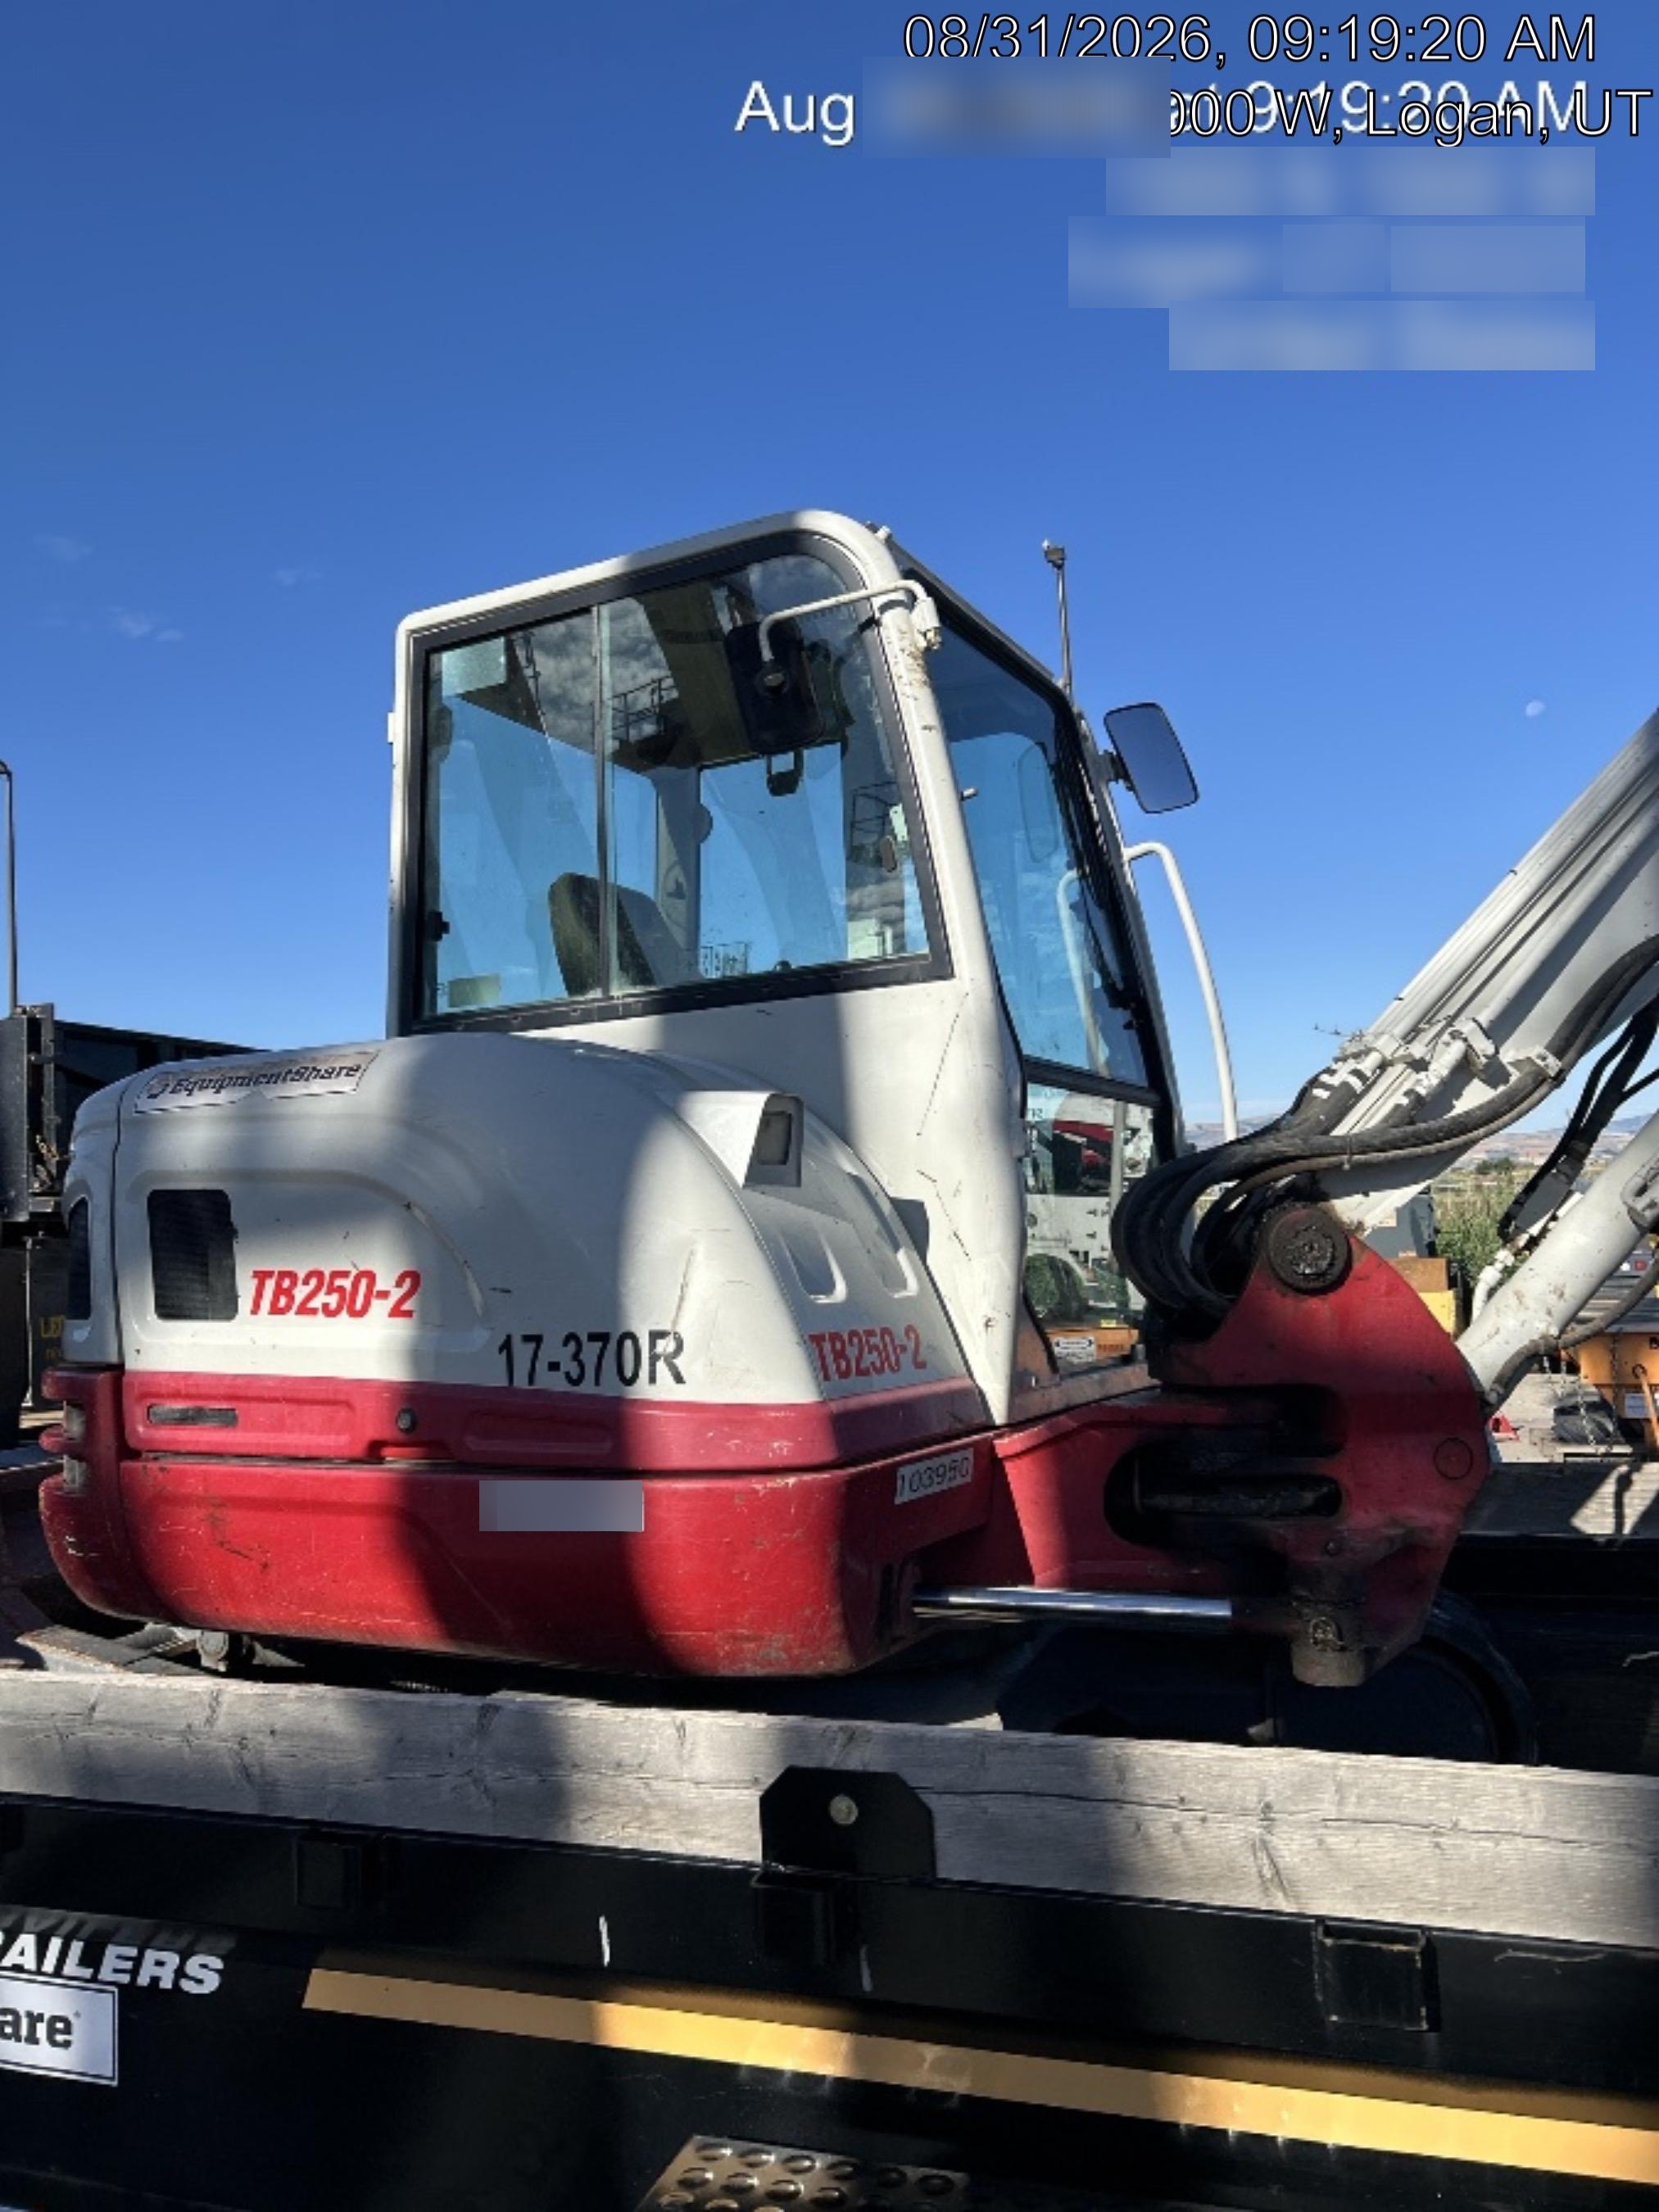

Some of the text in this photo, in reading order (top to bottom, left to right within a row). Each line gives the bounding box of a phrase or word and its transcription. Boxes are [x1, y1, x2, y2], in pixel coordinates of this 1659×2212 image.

[169, 1063, 362, 1097] EquipmentShare
[250, 1269, 421, 1319] TB250-2
[498, 1329, 687, 1387] 17-370R
[809, 1324, 927, 1382] TB250-2
[0, 1930, 224, 1994] AILERS
